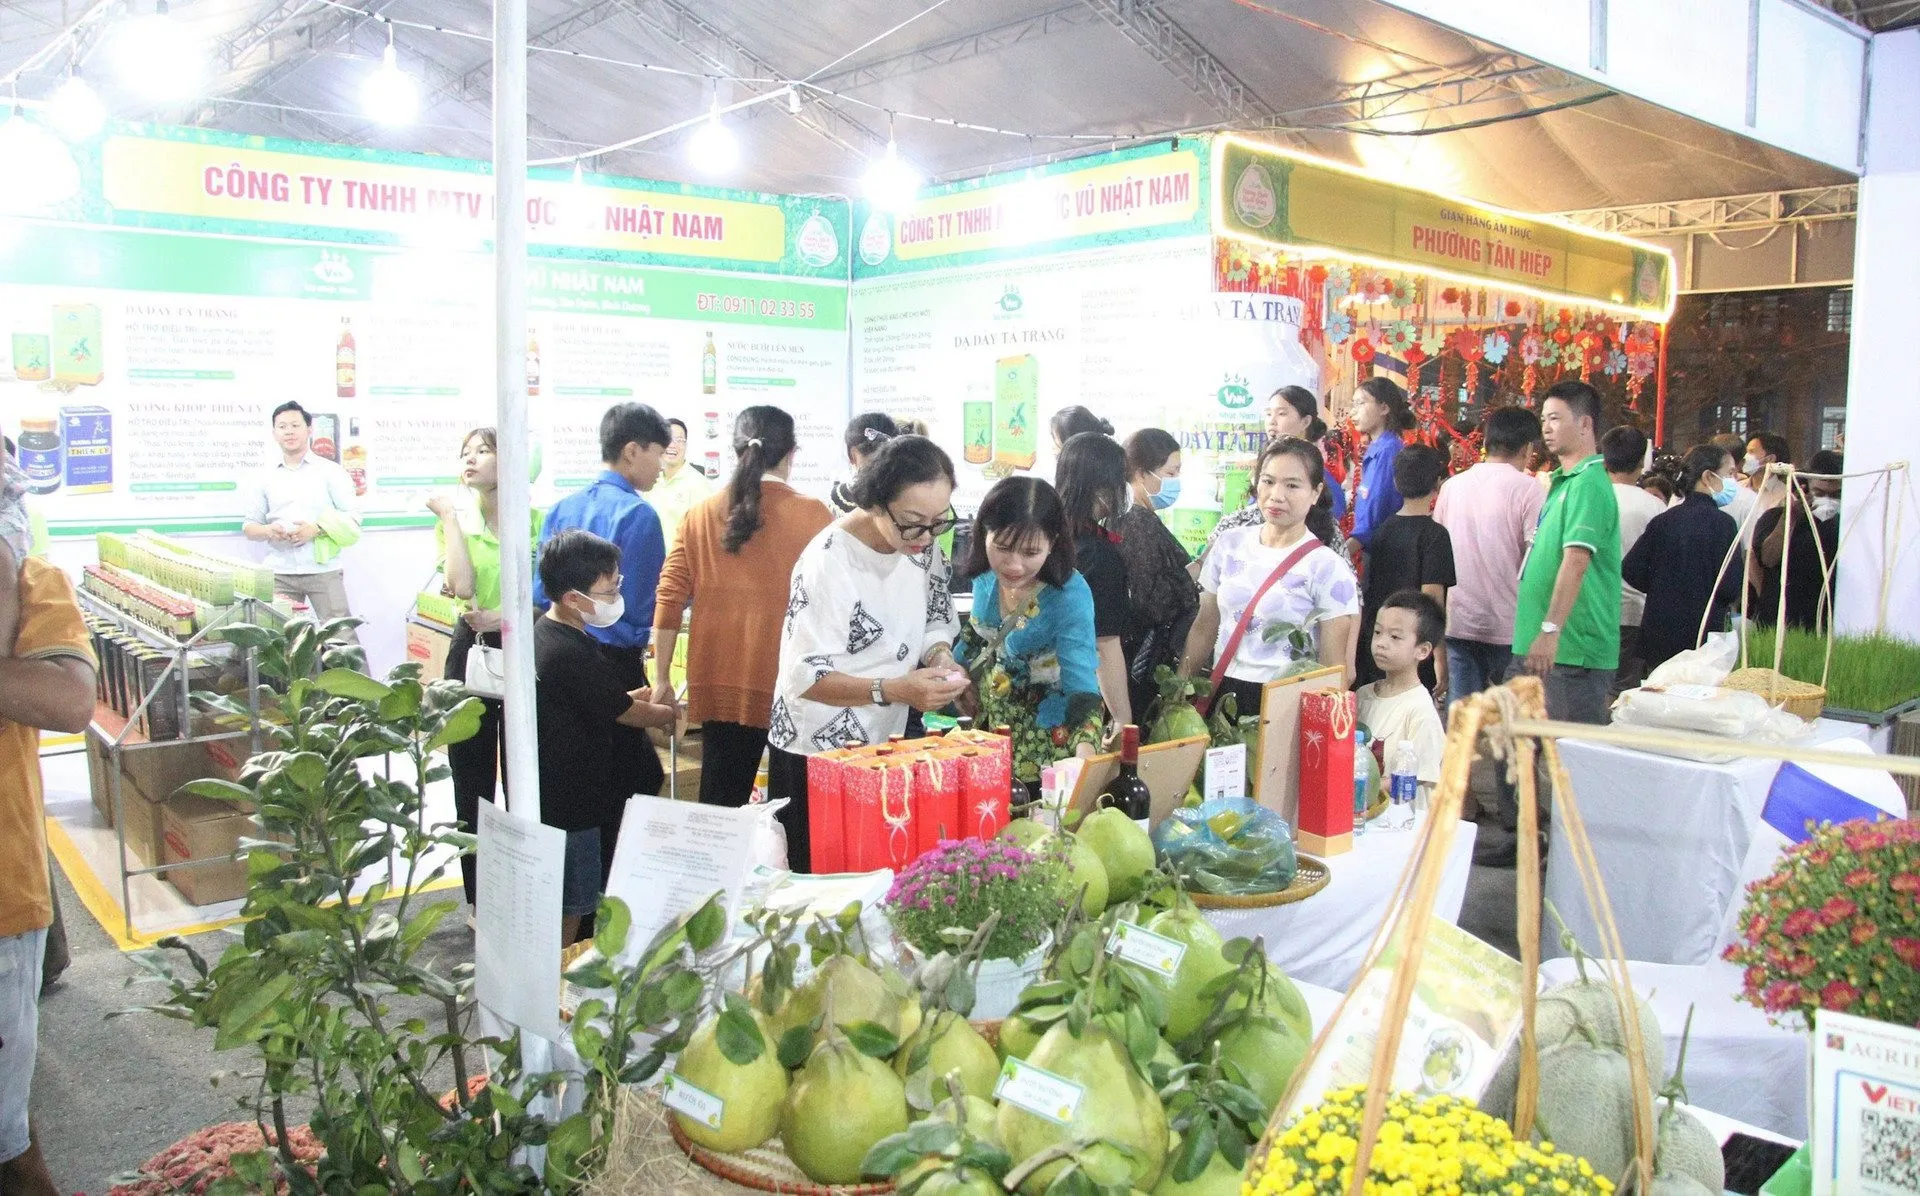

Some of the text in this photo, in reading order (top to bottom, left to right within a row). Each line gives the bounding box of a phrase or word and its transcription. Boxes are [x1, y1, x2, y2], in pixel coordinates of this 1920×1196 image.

[204, 162, 289, 203] CÔNG
[299, 176, 333, 206] TY
[342, 180, 417, 214] TNHH
[605, 203, 666, 240] NHẬT
[672, 212, 724, 241] NAM
[900, 212, 934, 245] CÔNG
[937, 213, 953, 239] TY
[956, 206, 992, 236] TNHH
[1075, 183, 1095, 218] VŨ
[1100, 176, 1145, 217] NHẬT
[1149, 172, 1190, 207] NAM
[1439, 208, 1464, 225] GIAN
[1412, 225, 1553, 281] PHƯỜNG TÂN HIỆP
[603, 274, 645, 297] NAM
[697, 294, 815, 319] ĐT: 0911 02 33 55
[1230, 292, 1256, 321] TÁ
[1860, 1081, 1920, 1114] VIET
